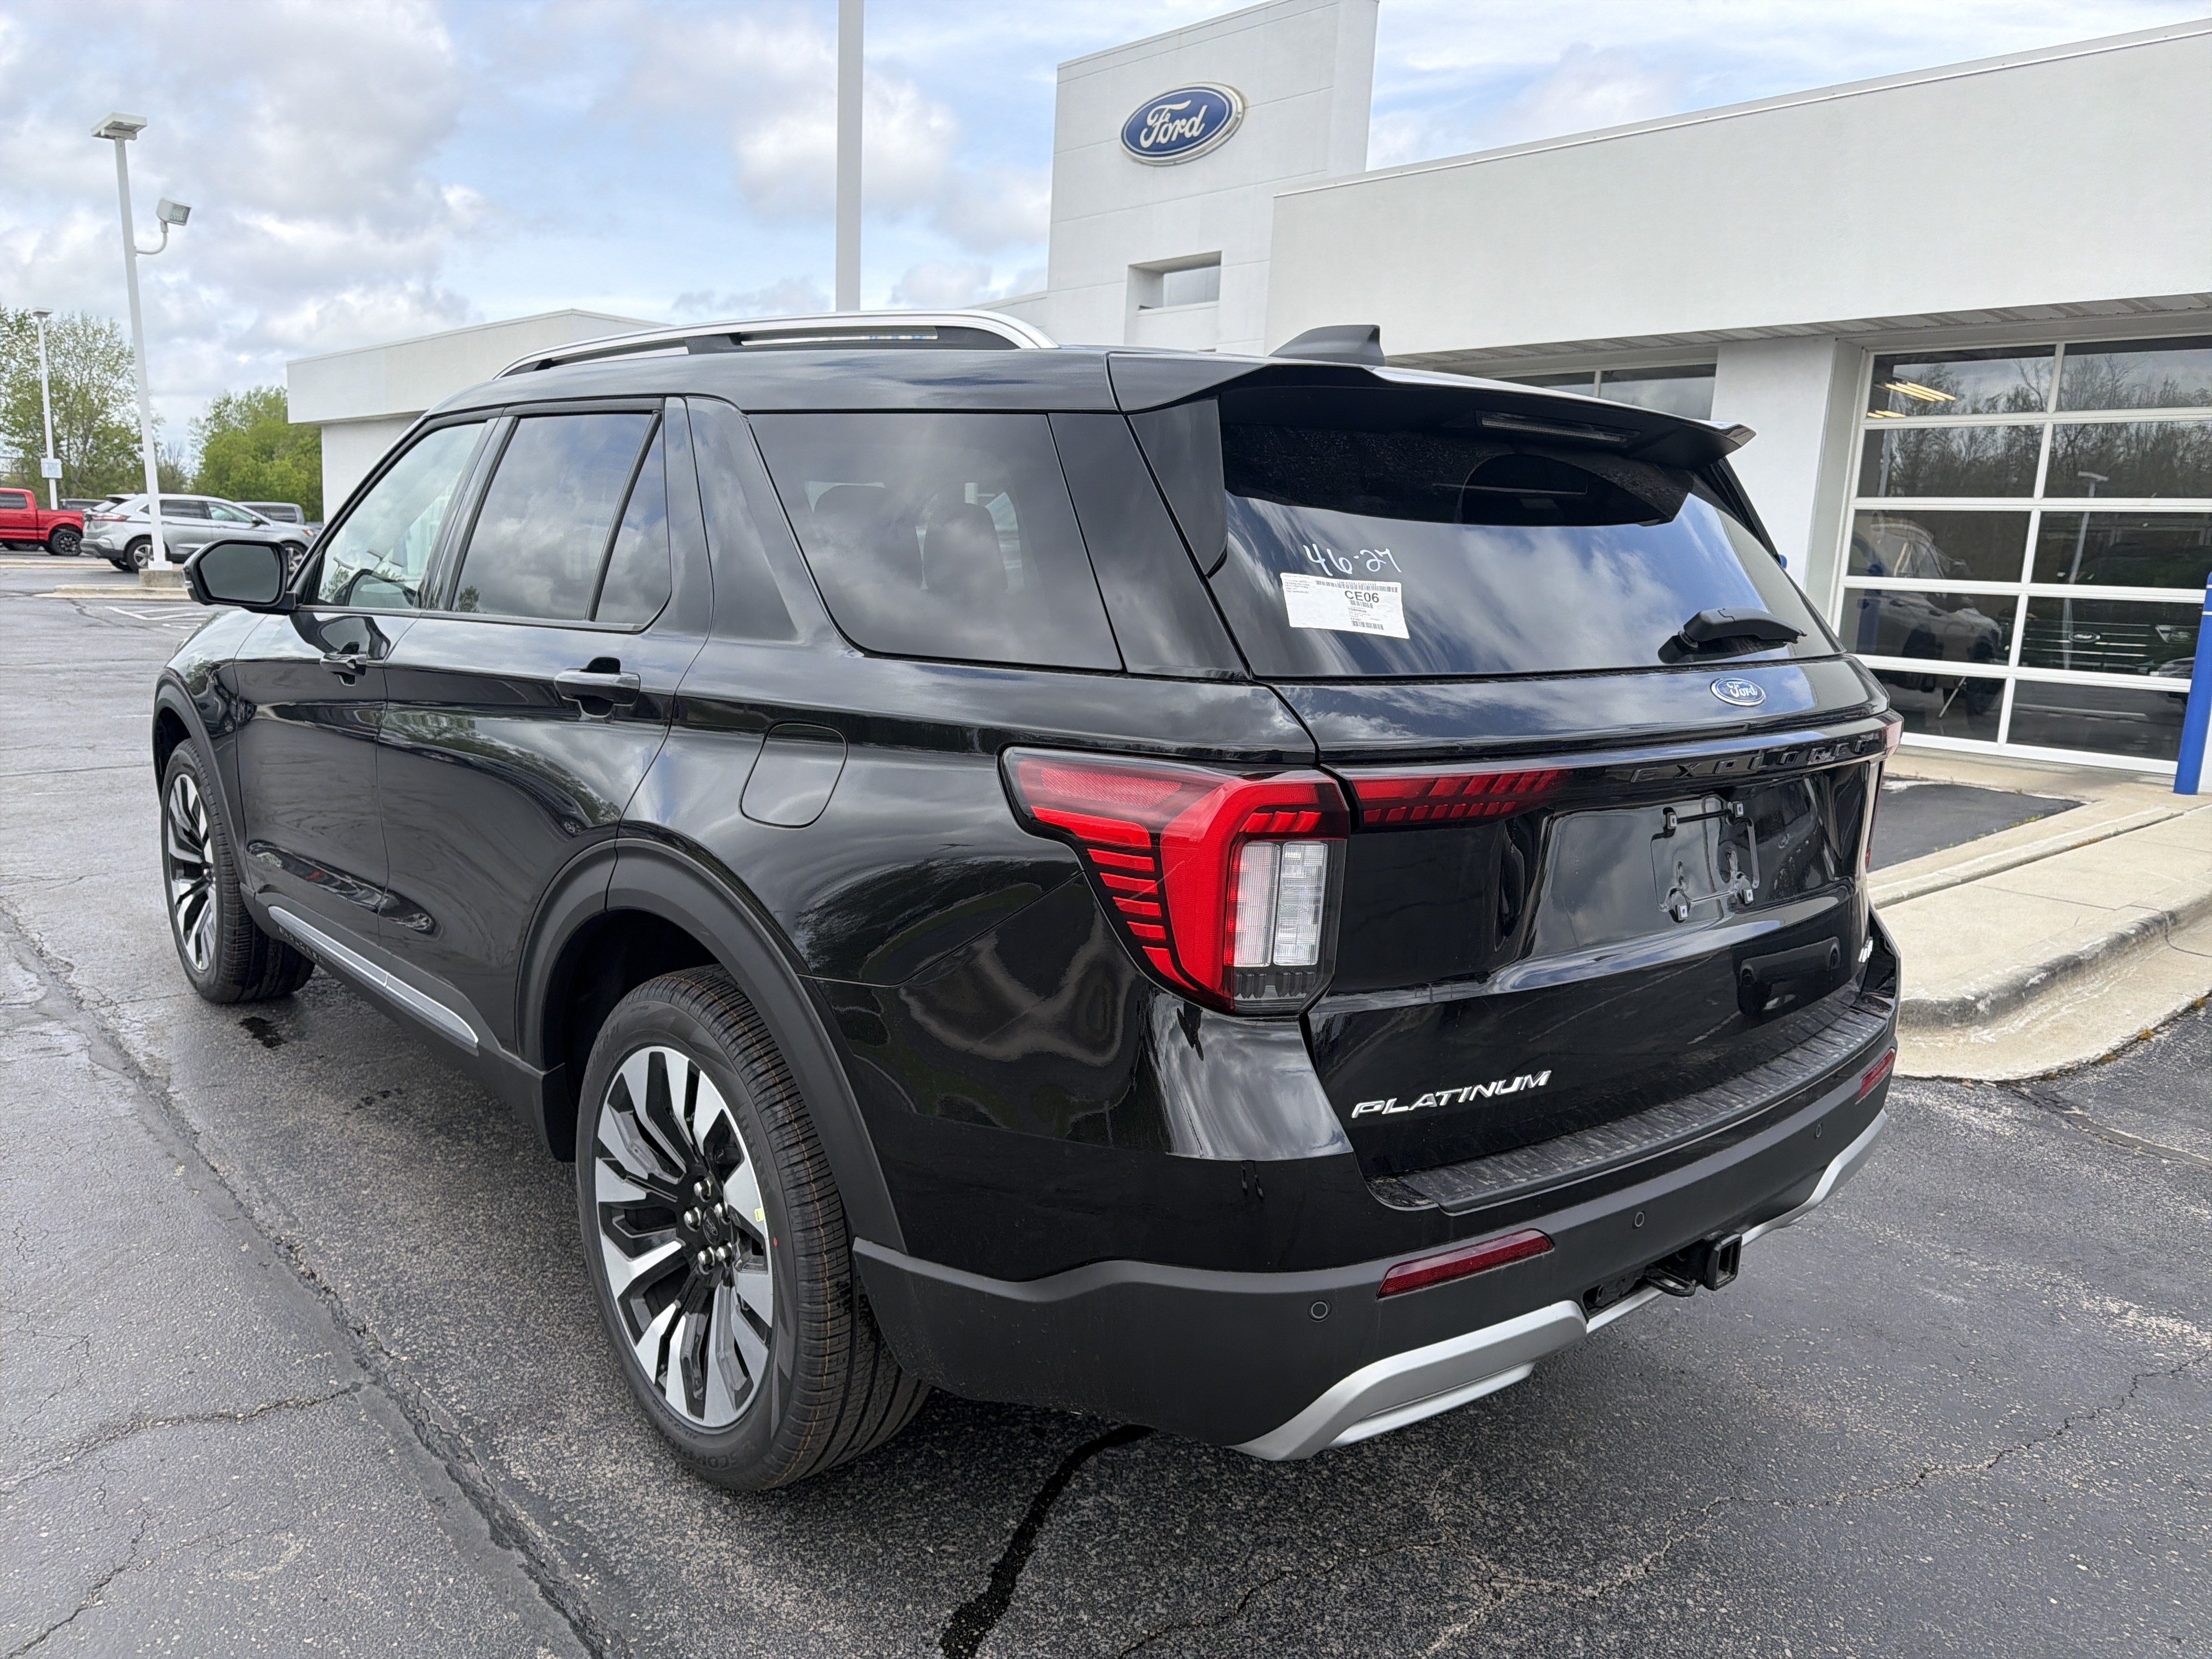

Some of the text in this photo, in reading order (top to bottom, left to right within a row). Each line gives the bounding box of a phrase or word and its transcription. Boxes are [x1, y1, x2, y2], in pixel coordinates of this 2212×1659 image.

[1139, 99, 1208, 149] Ford
[1345, 590, 1380, 603] CE06
[1726, 680, 1758, 697] Ford
[1351, 1070, 1552, 1119] PLATINUM
